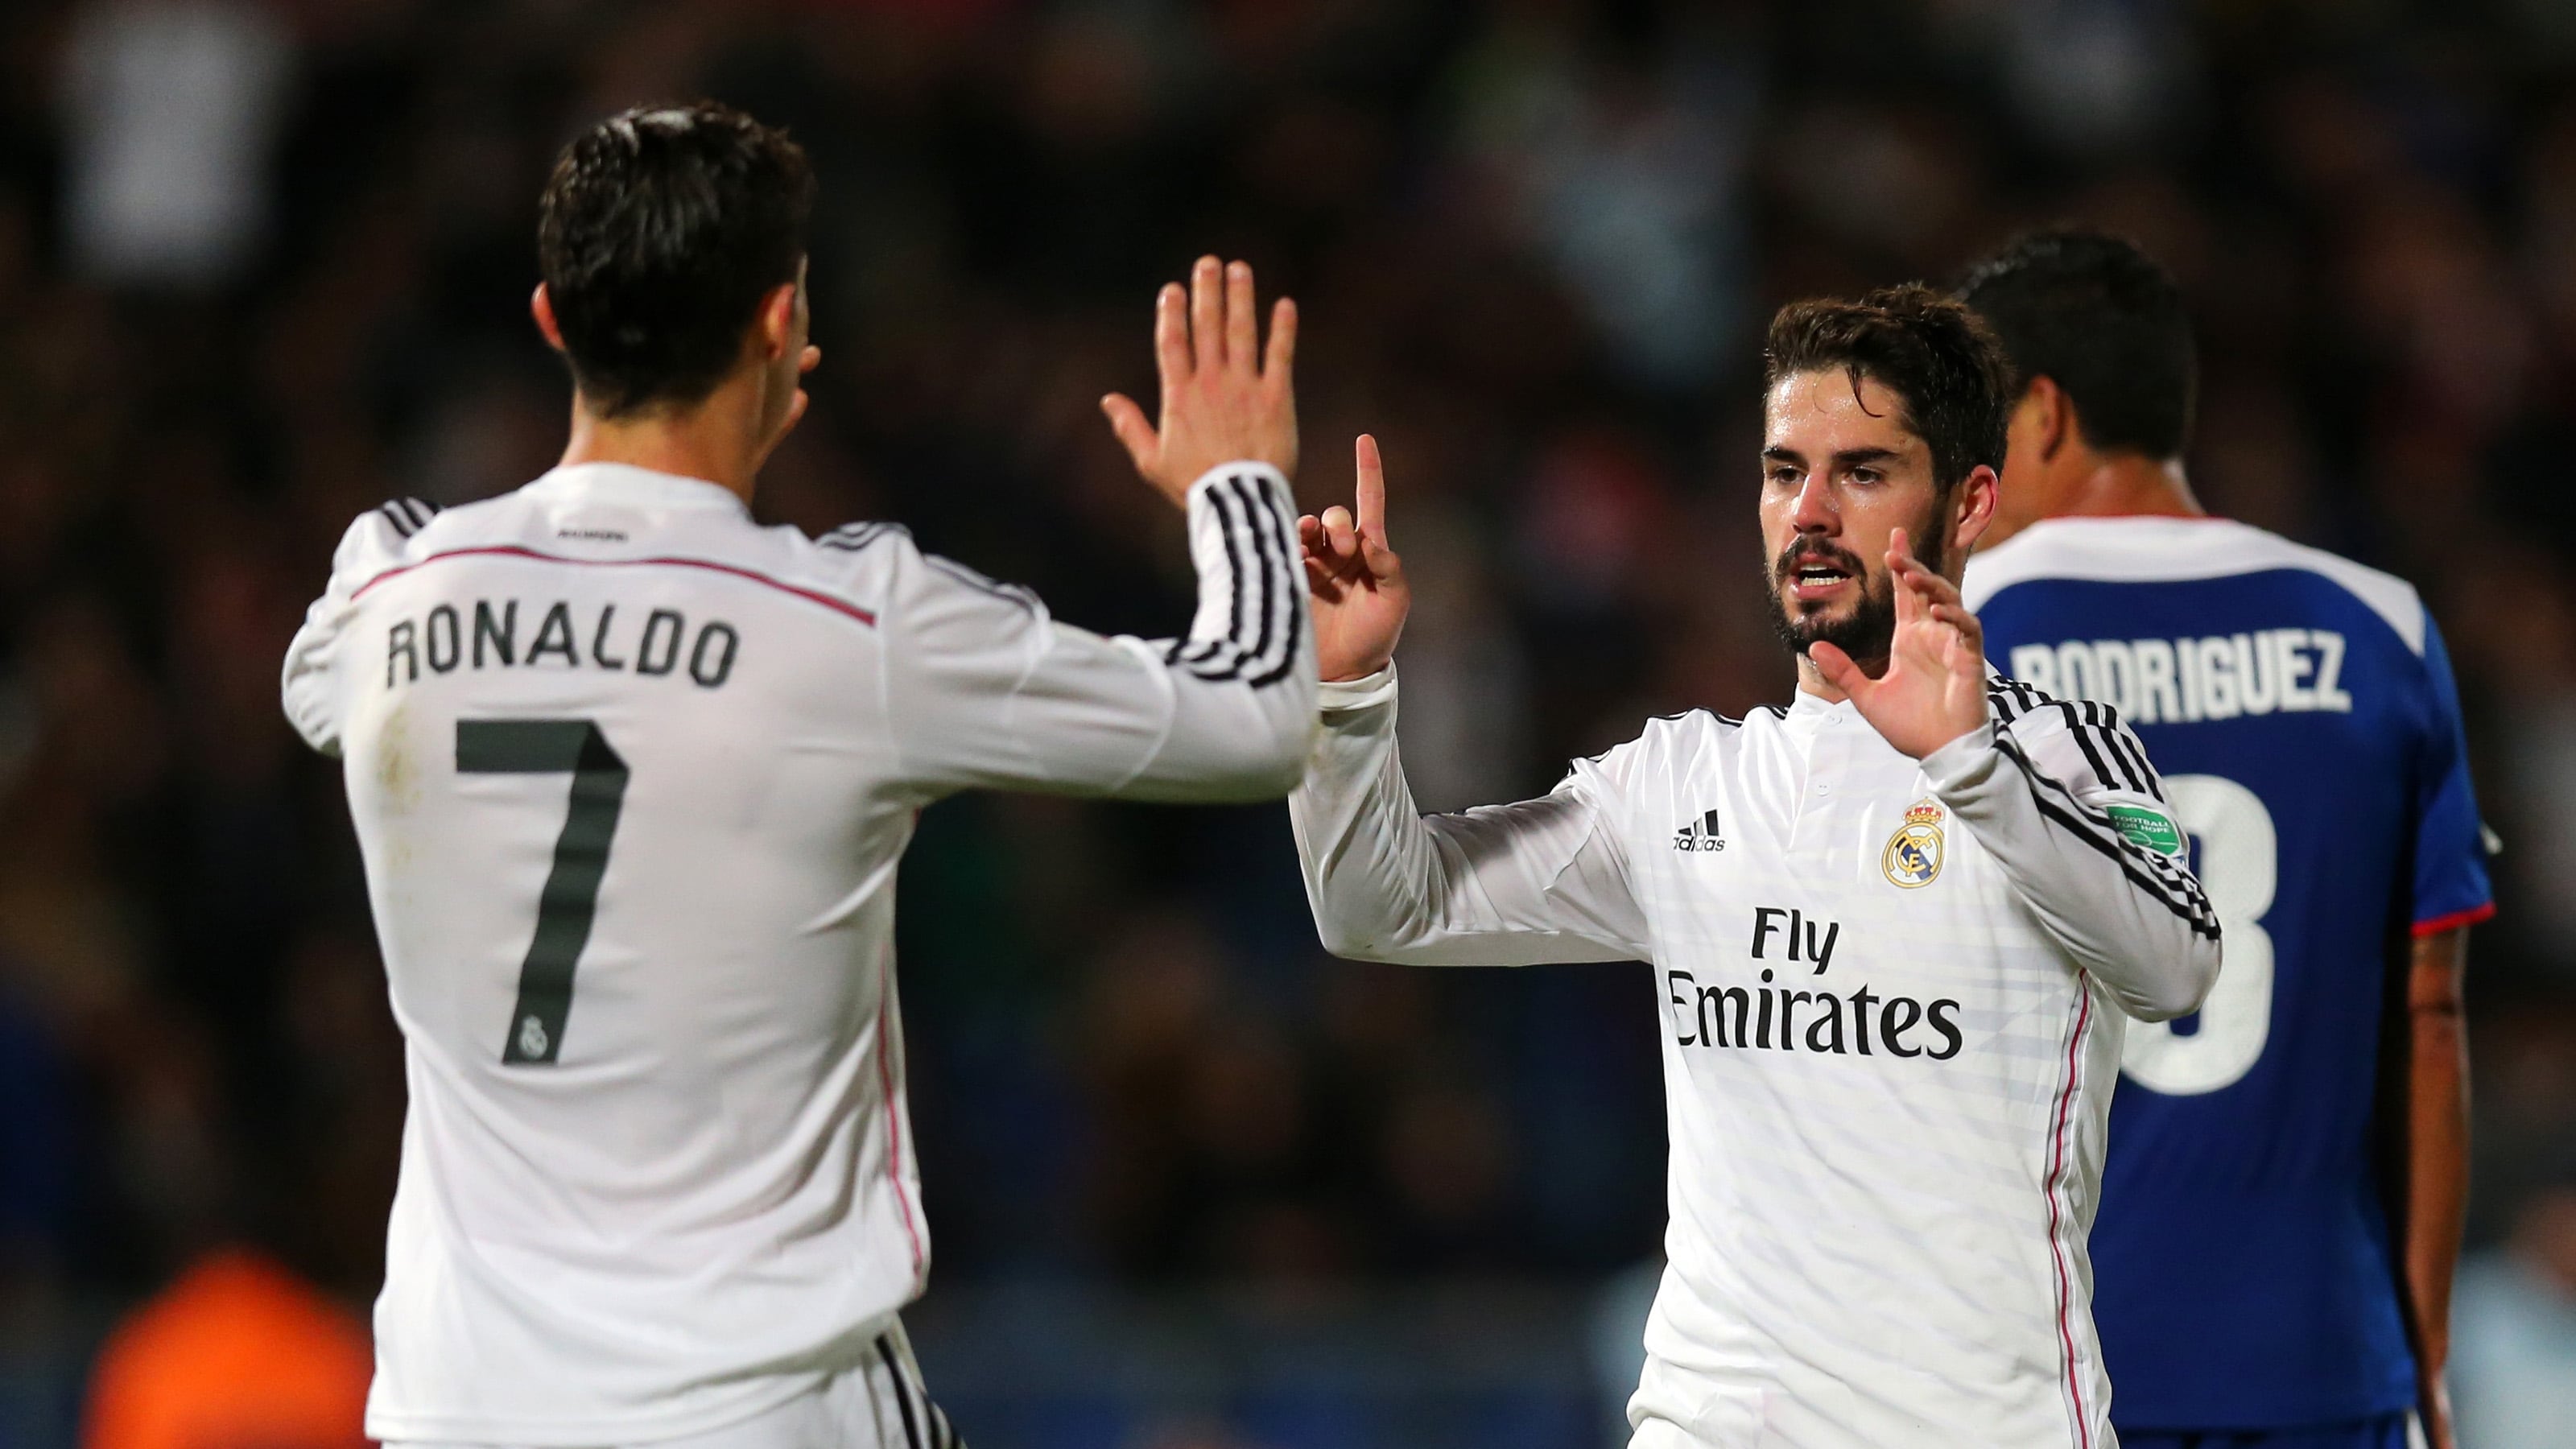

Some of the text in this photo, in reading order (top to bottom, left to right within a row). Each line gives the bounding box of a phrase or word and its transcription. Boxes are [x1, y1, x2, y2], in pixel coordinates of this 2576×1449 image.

[386, 599, 739, 688] RONALDO
[2012, 630, 2351, 724] RODRIGUEZ
[2114, 815, 2169, 828] FOOTBALL
[2140, 824, 2171, 833] HOPE
[456, 719, 630, 1064] 7
[1751, 906, 1839, 976] Fly
[1668, 968, 1964, 1060] Emirates
